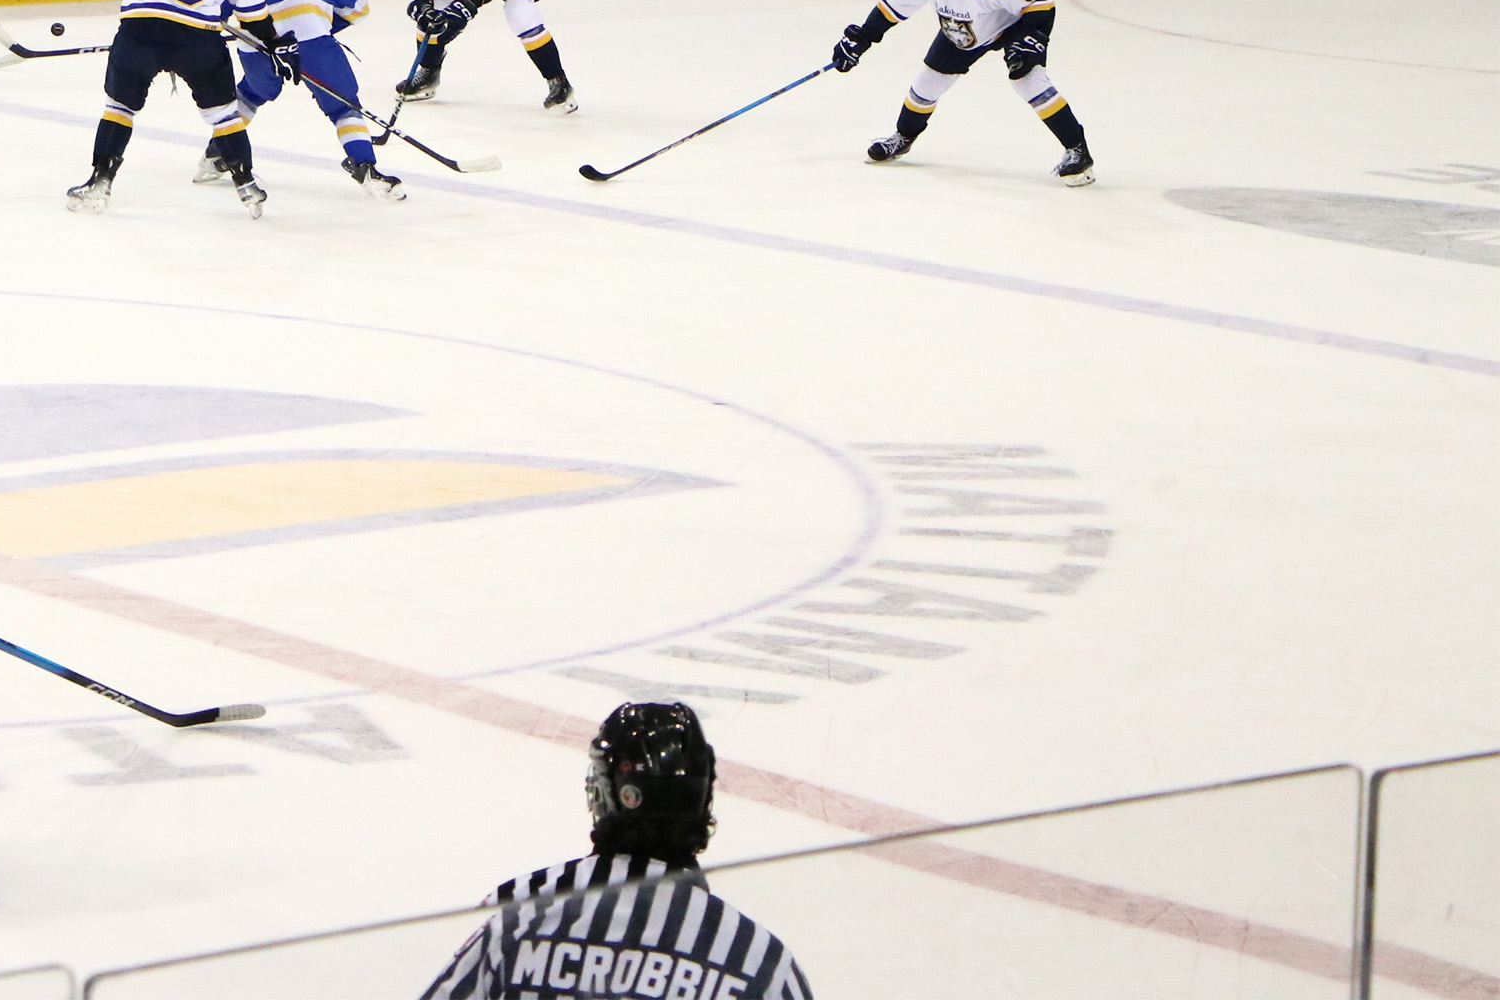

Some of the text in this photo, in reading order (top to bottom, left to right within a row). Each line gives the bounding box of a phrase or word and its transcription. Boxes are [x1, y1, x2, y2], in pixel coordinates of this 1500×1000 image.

[79, 46, 111, 55] CC
[274, 43, 299, 55] CC
[1023, 35, 1046, 53] CC
[86, 682, 136, 708] CCM
[511, 939, 749, 1000] MCROBBIE
